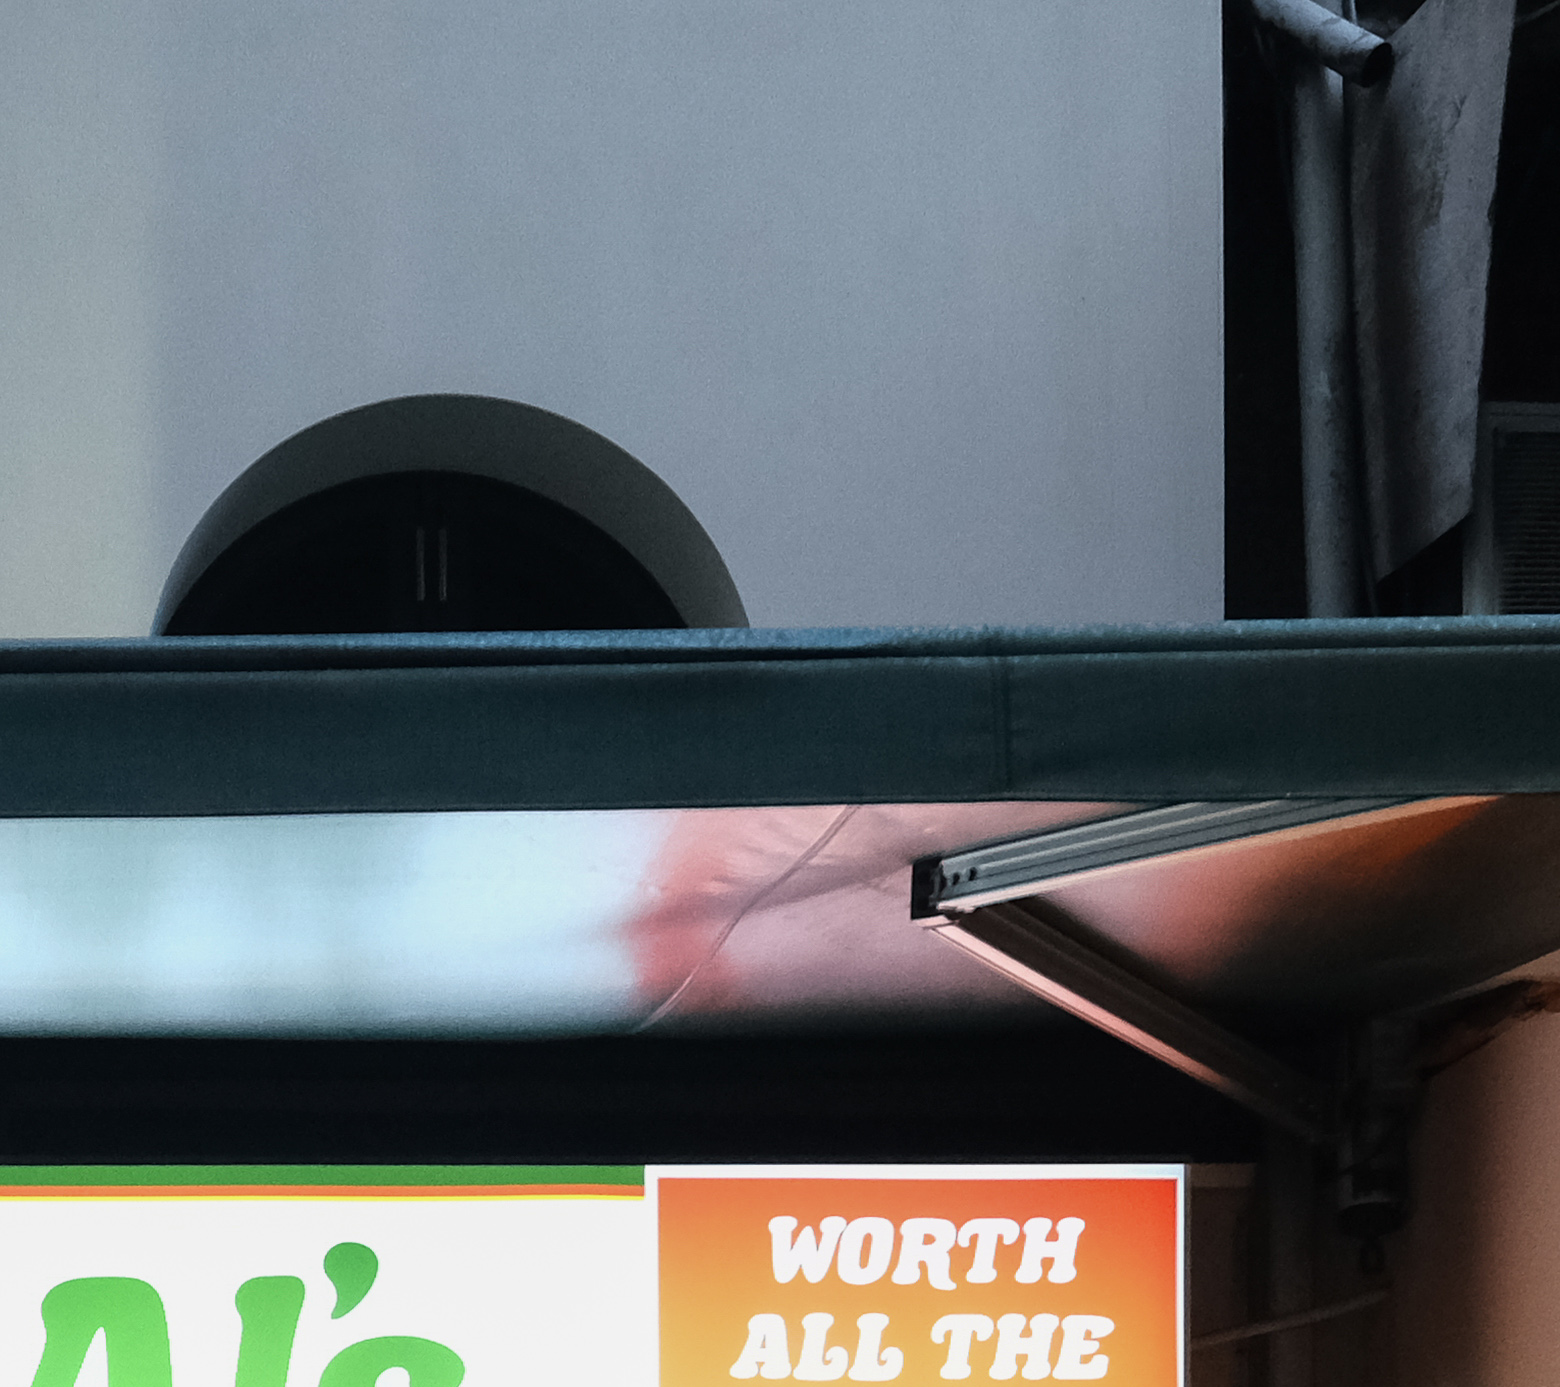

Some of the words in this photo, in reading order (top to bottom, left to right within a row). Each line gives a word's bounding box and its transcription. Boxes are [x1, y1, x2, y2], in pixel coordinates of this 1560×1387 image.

[768, 1215, 1086, 1291] WORTH
[729, 1312, 904, 1382] ALL
[930, 1313, 1116, 1380] THE
